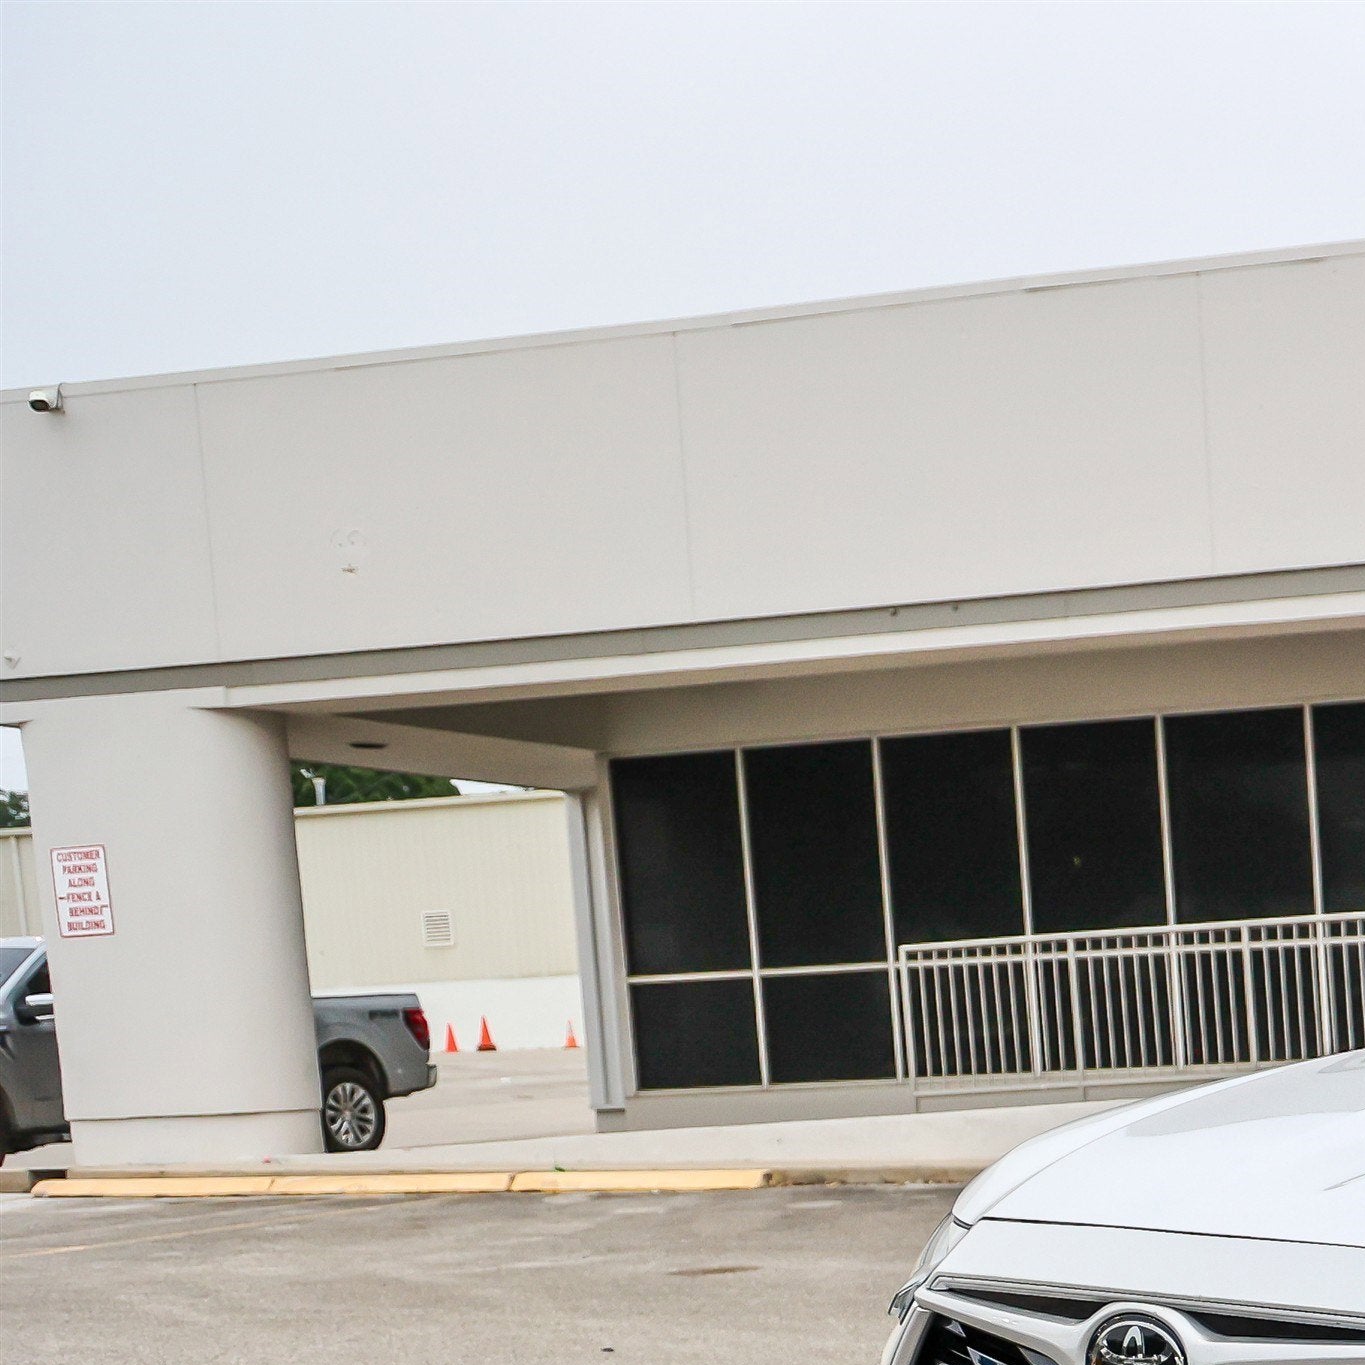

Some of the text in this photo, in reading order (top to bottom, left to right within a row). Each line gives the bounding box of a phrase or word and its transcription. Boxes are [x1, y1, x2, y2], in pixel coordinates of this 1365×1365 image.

[57, 850, 100, 862] CUSTOMER
[62, 862, 98, 874] PARKING
[68, 877, 95, 888] ALONG
[69, 905, 99, 917] BEHIND
[67, 919, 105, 932] BUILDING
